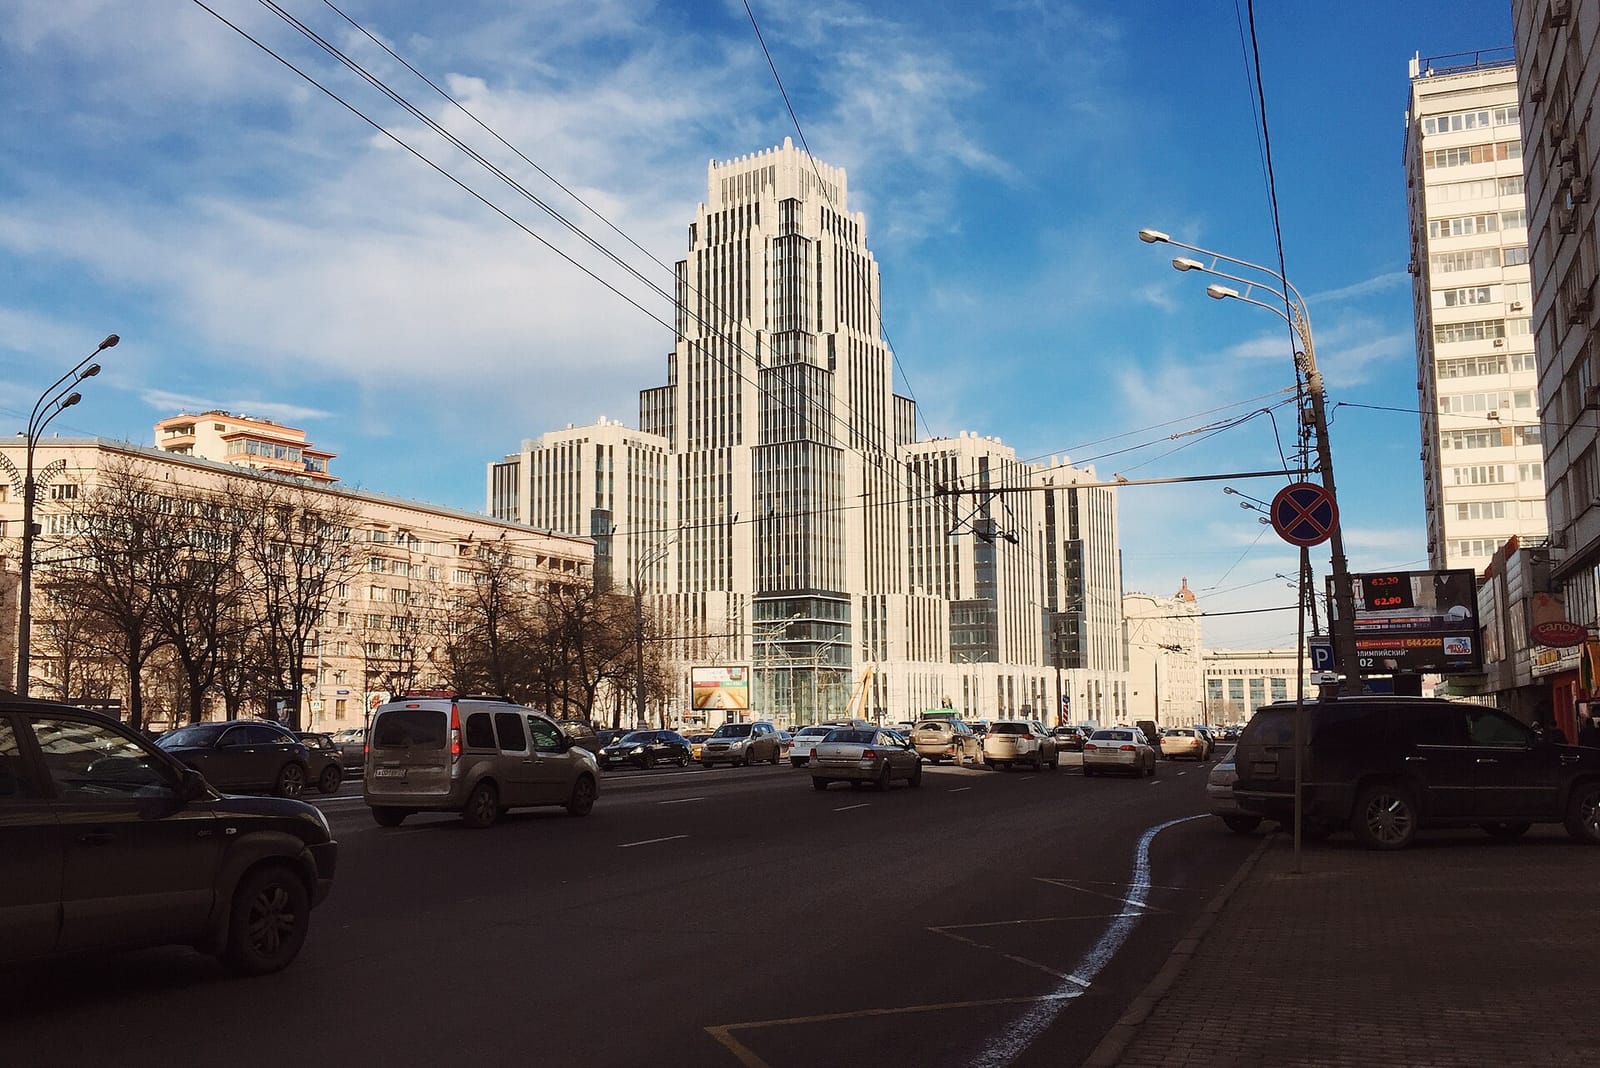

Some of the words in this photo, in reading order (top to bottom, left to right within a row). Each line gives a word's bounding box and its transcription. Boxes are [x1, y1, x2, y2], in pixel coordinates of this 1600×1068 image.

[1371, 576, 1399, 586] 62.20
[1374, 596, 1402, 606] 62.90
[1539, 623, 1579, 634] салон
[1315, 648, 1329, 668] P
[1359, 658, 1374, 668] 02
